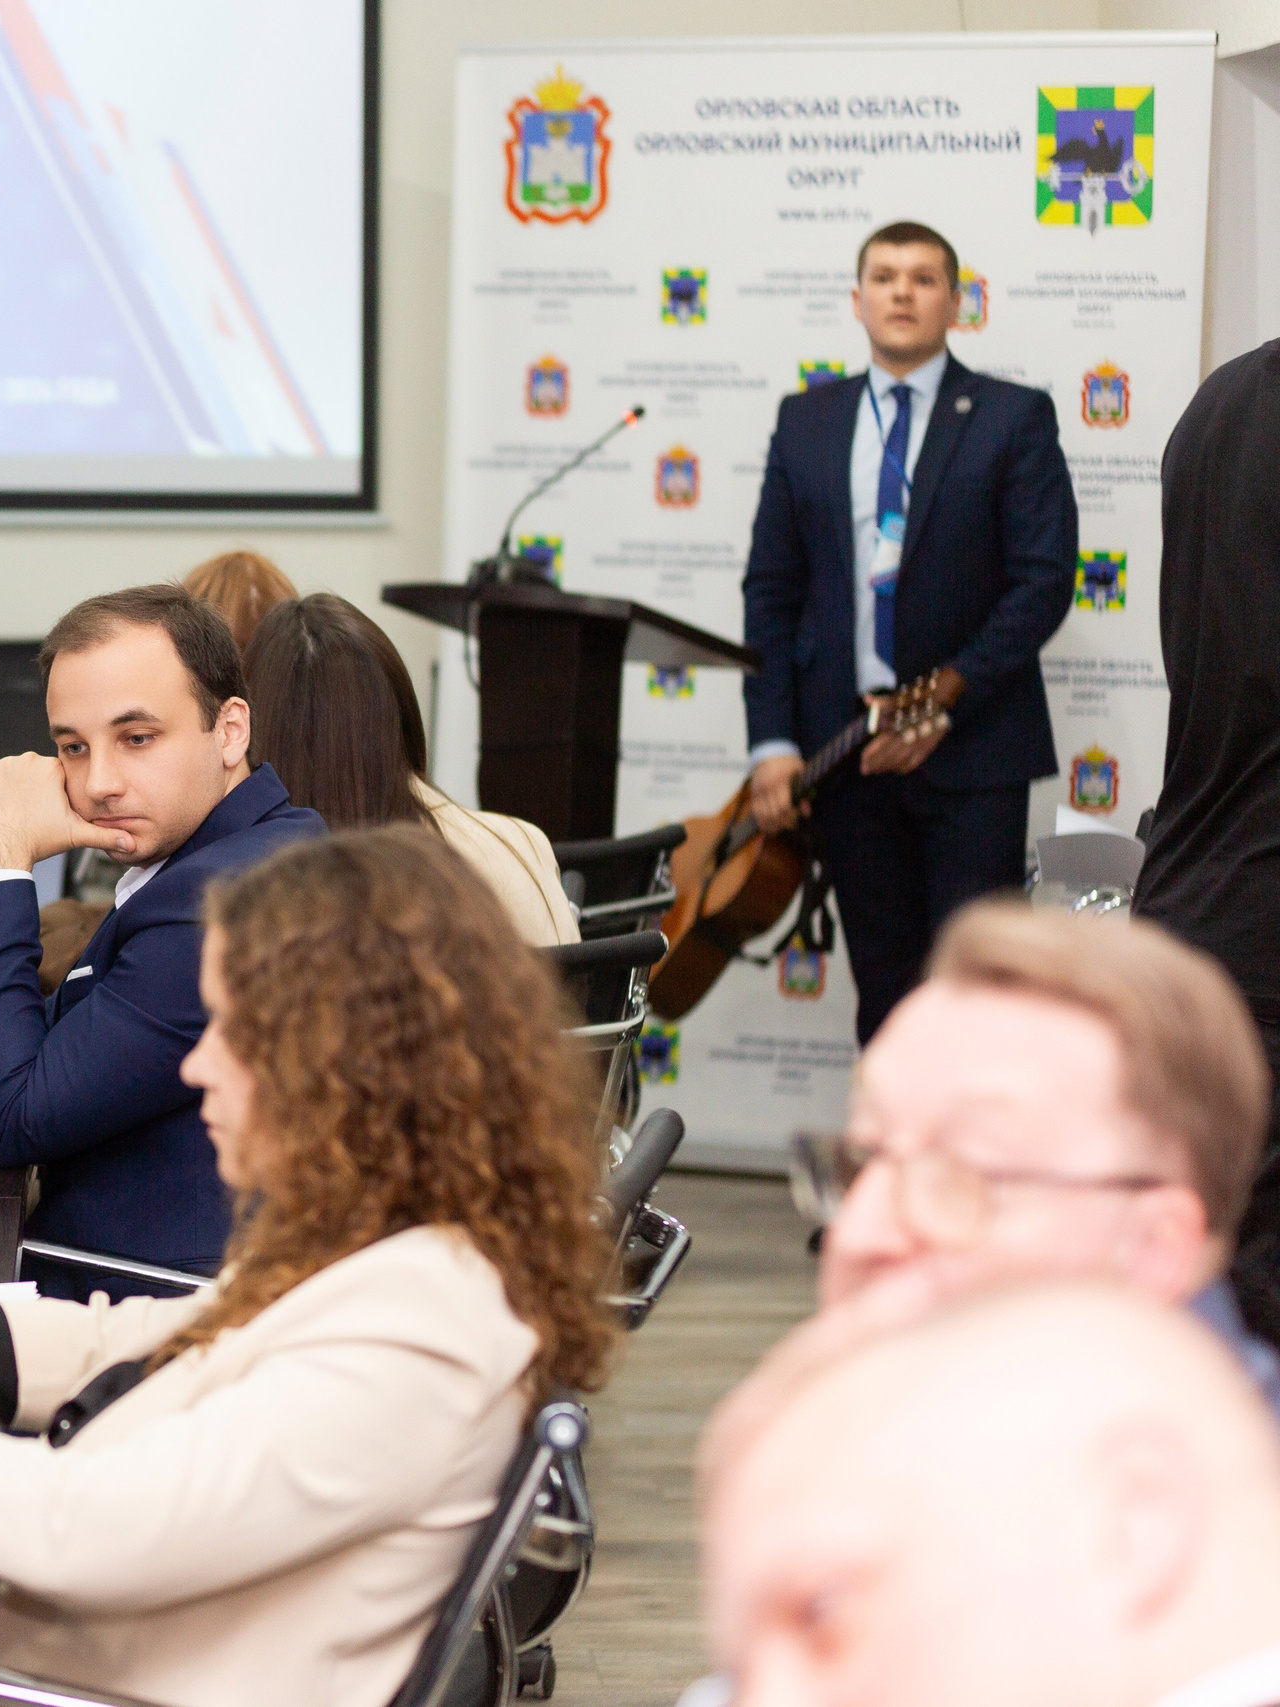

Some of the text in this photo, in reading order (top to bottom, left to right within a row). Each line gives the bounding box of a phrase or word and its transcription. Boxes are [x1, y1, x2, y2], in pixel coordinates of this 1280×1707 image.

[695, 96, 961, 119] ОРЛОВСКАЯ ОБЛАСТЬ
[634, 127, 1022, 156] ОРЛОВСКИЙ МУНИЦИПАЛЬНЫЙ
[786, 166, 864, 189] ОКРУГ
